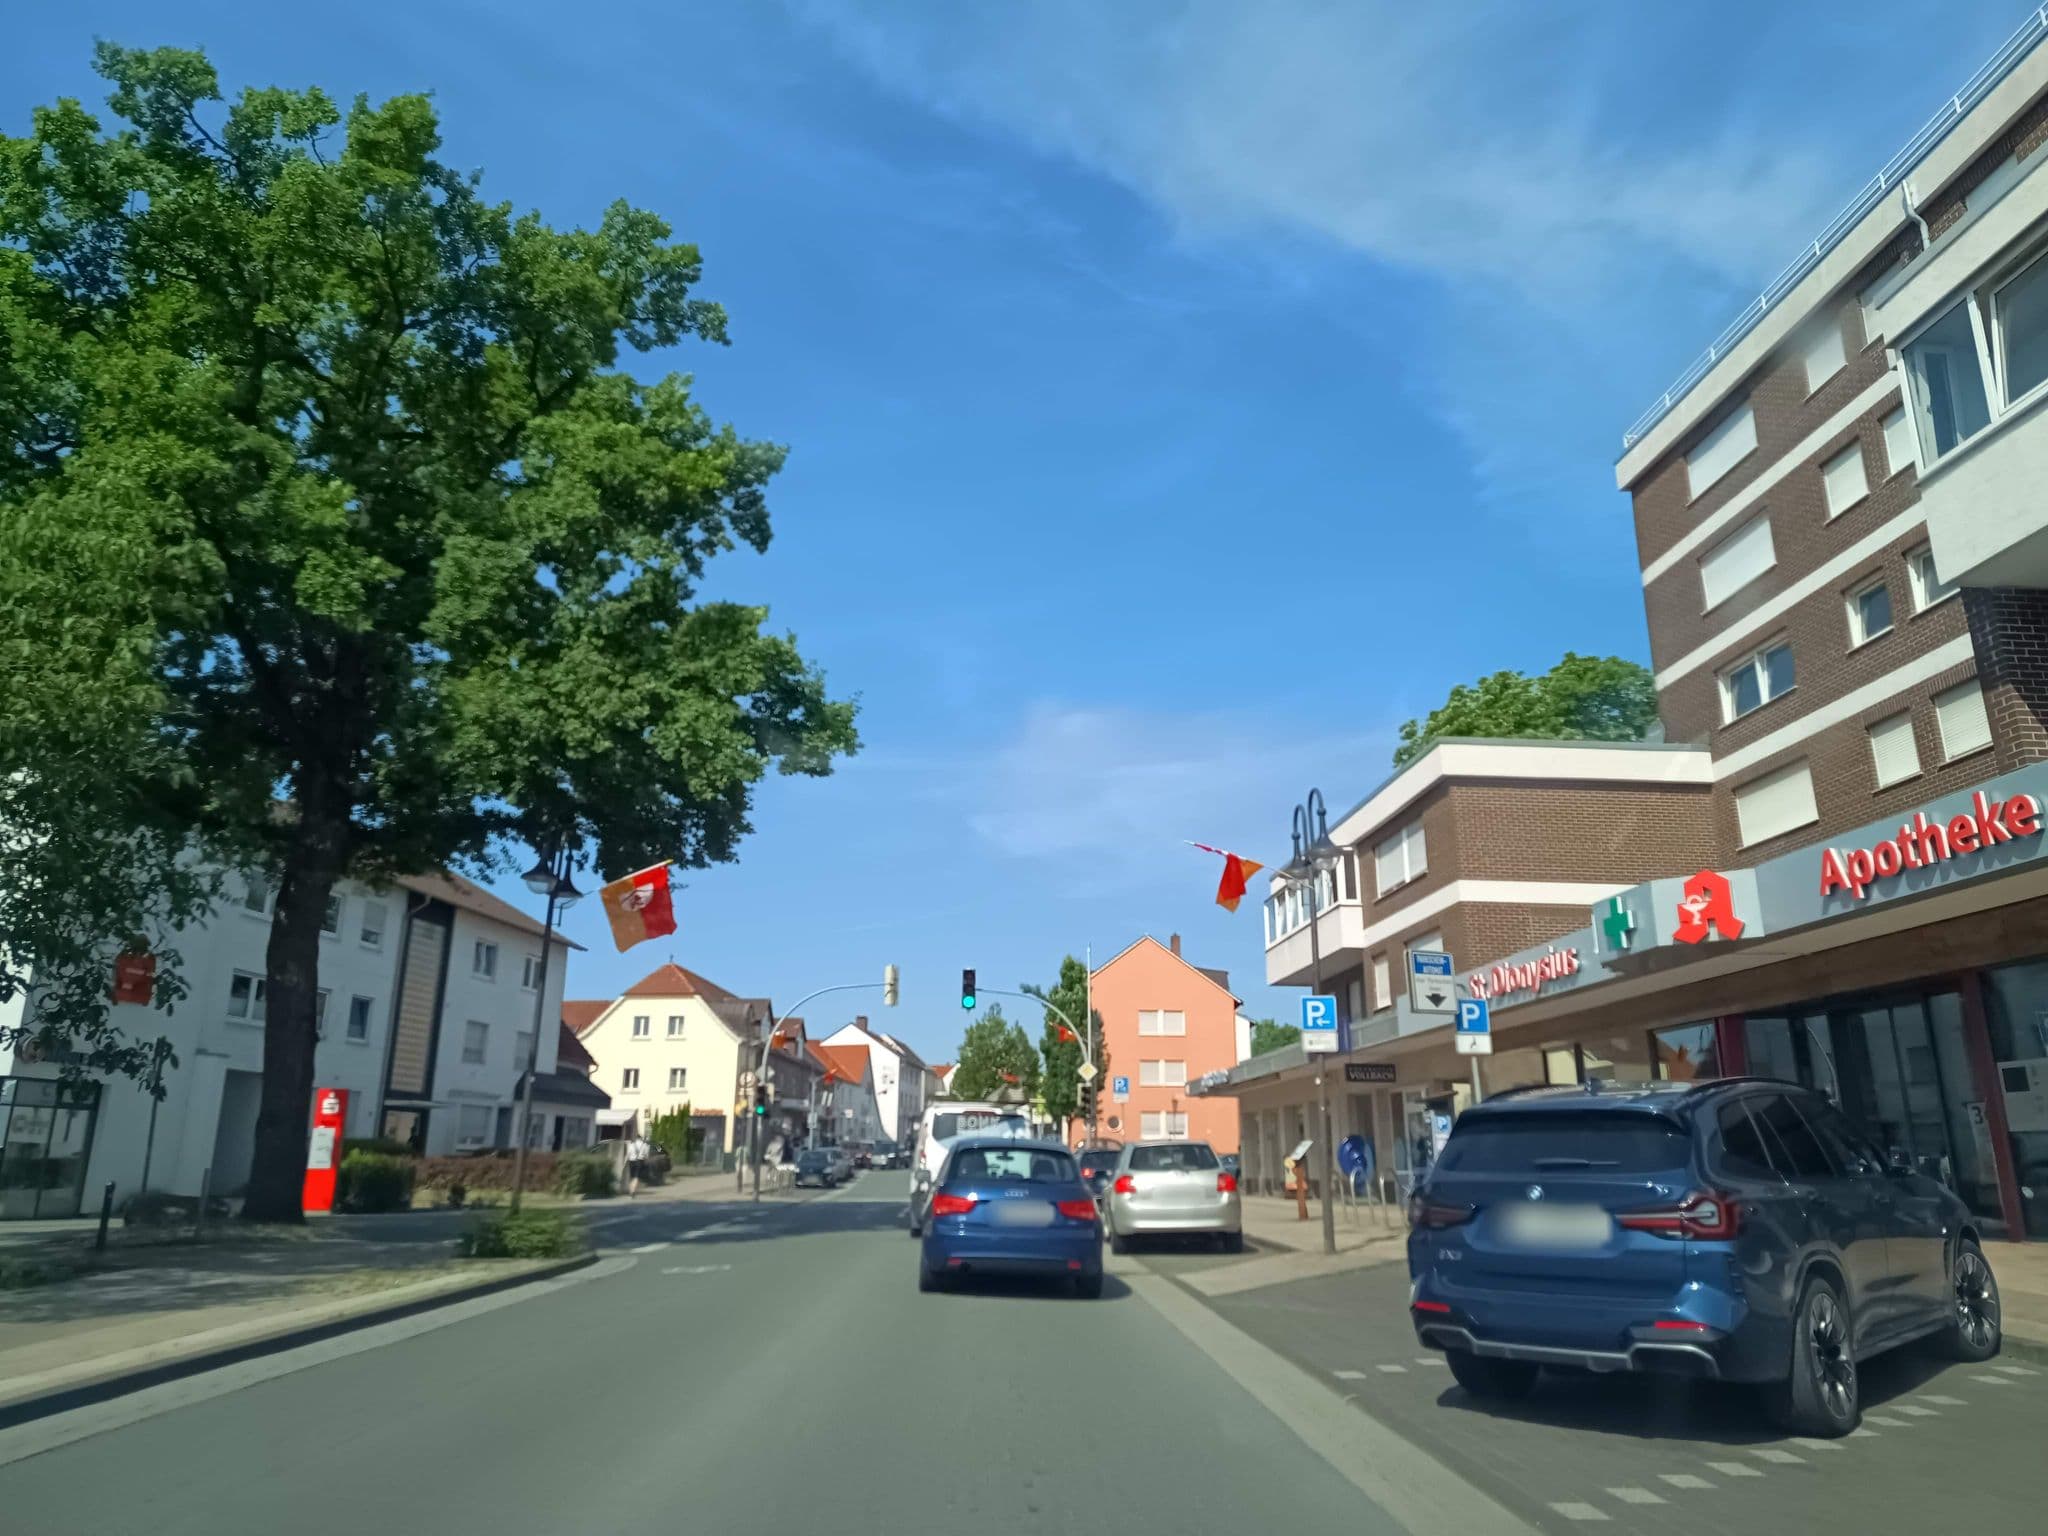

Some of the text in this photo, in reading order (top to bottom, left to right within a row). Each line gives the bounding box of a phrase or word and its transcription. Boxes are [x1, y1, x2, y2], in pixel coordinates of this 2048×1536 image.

[1819, 790, 2043, 899] Apotheke
[1306, 1000, 1326, 1027] P
[1461, 1002, 1480, 1030] P
[1971, 1106, 1984, 1125] 3
